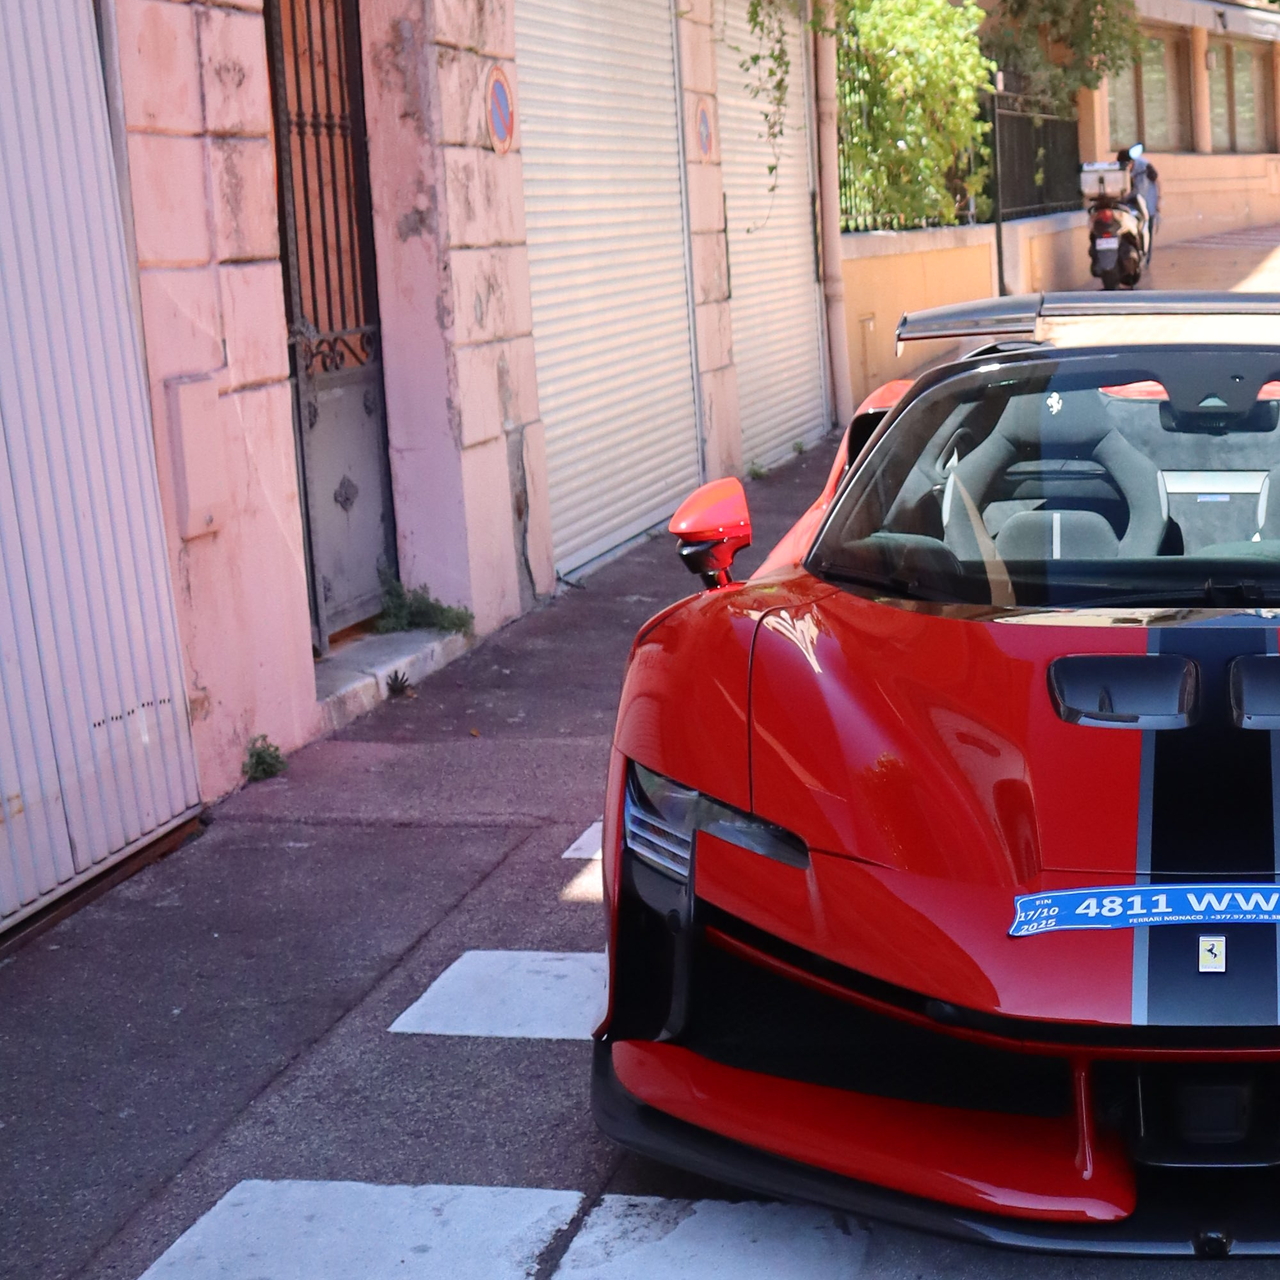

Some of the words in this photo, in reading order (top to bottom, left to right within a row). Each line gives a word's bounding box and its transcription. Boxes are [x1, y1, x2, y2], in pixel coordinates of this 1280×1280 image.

[1075, 894, 1173, 917] 4811
[1019, 907, 1059, 921] 17/10
[1021, 919, 1056, 933] 2025
